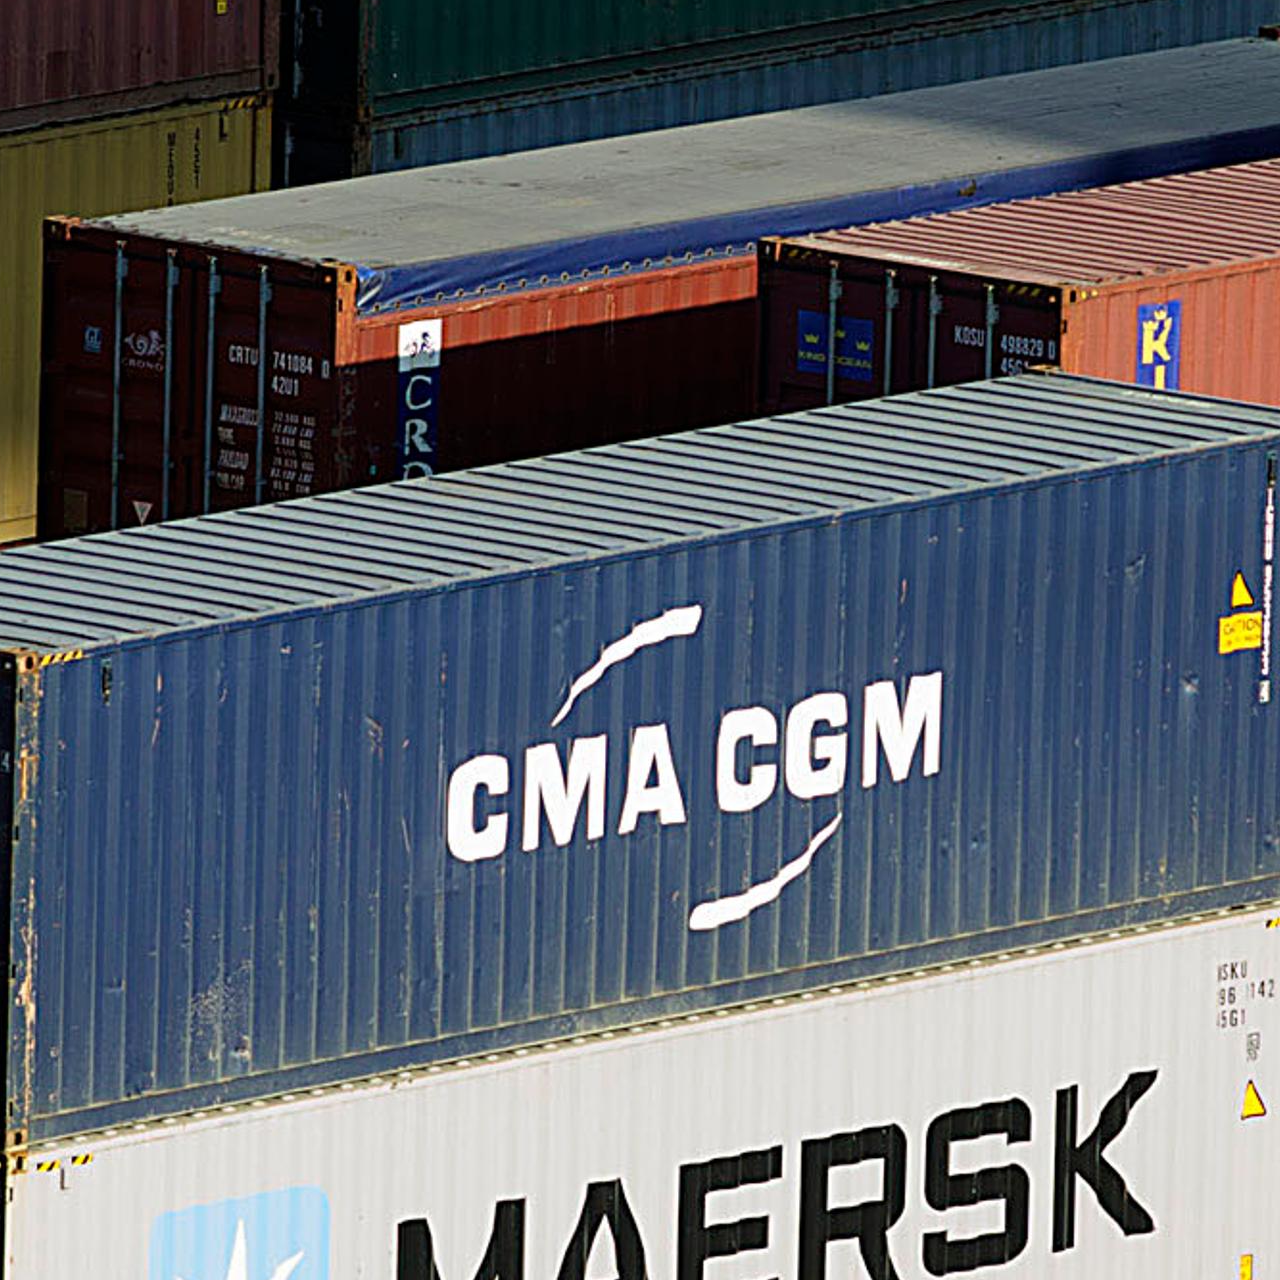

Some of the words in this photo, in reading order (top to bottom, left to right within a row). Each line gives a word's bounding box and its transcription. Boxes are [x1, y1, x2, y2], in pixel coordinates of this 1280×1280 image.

[955, 324, 985, 347] KOSU
[999, 334, 1045, 357] 498829
[228, 343, 259, 367] CRTU
[272, 351, 314, 376] 741084
[446, 722, 688, 862] CMA
[716, 671, 943, 814] CGM
